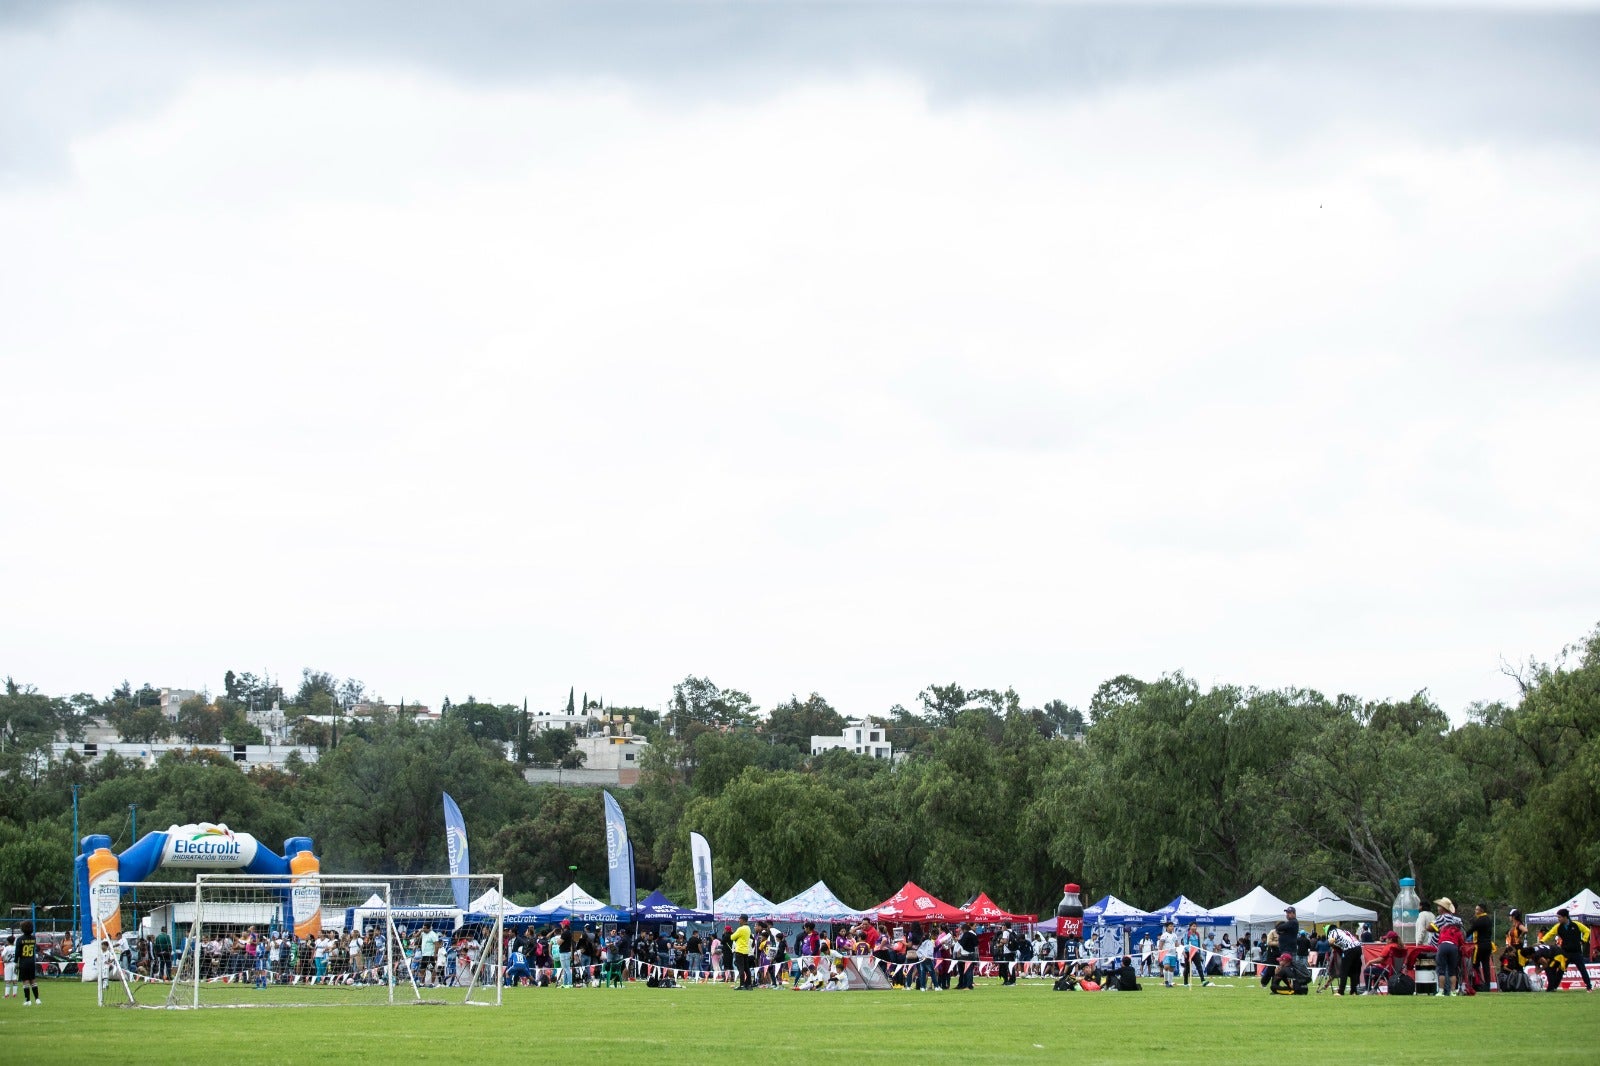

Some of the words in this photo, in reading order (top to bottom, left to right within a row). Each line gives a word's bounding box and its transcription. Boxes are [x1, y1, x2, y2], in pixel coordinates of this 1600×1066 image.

[174, 839, 240, 854] Electrolit
[583, 913, 619, 922] Electrolit
[1063, 919, 1080, 929] Red
